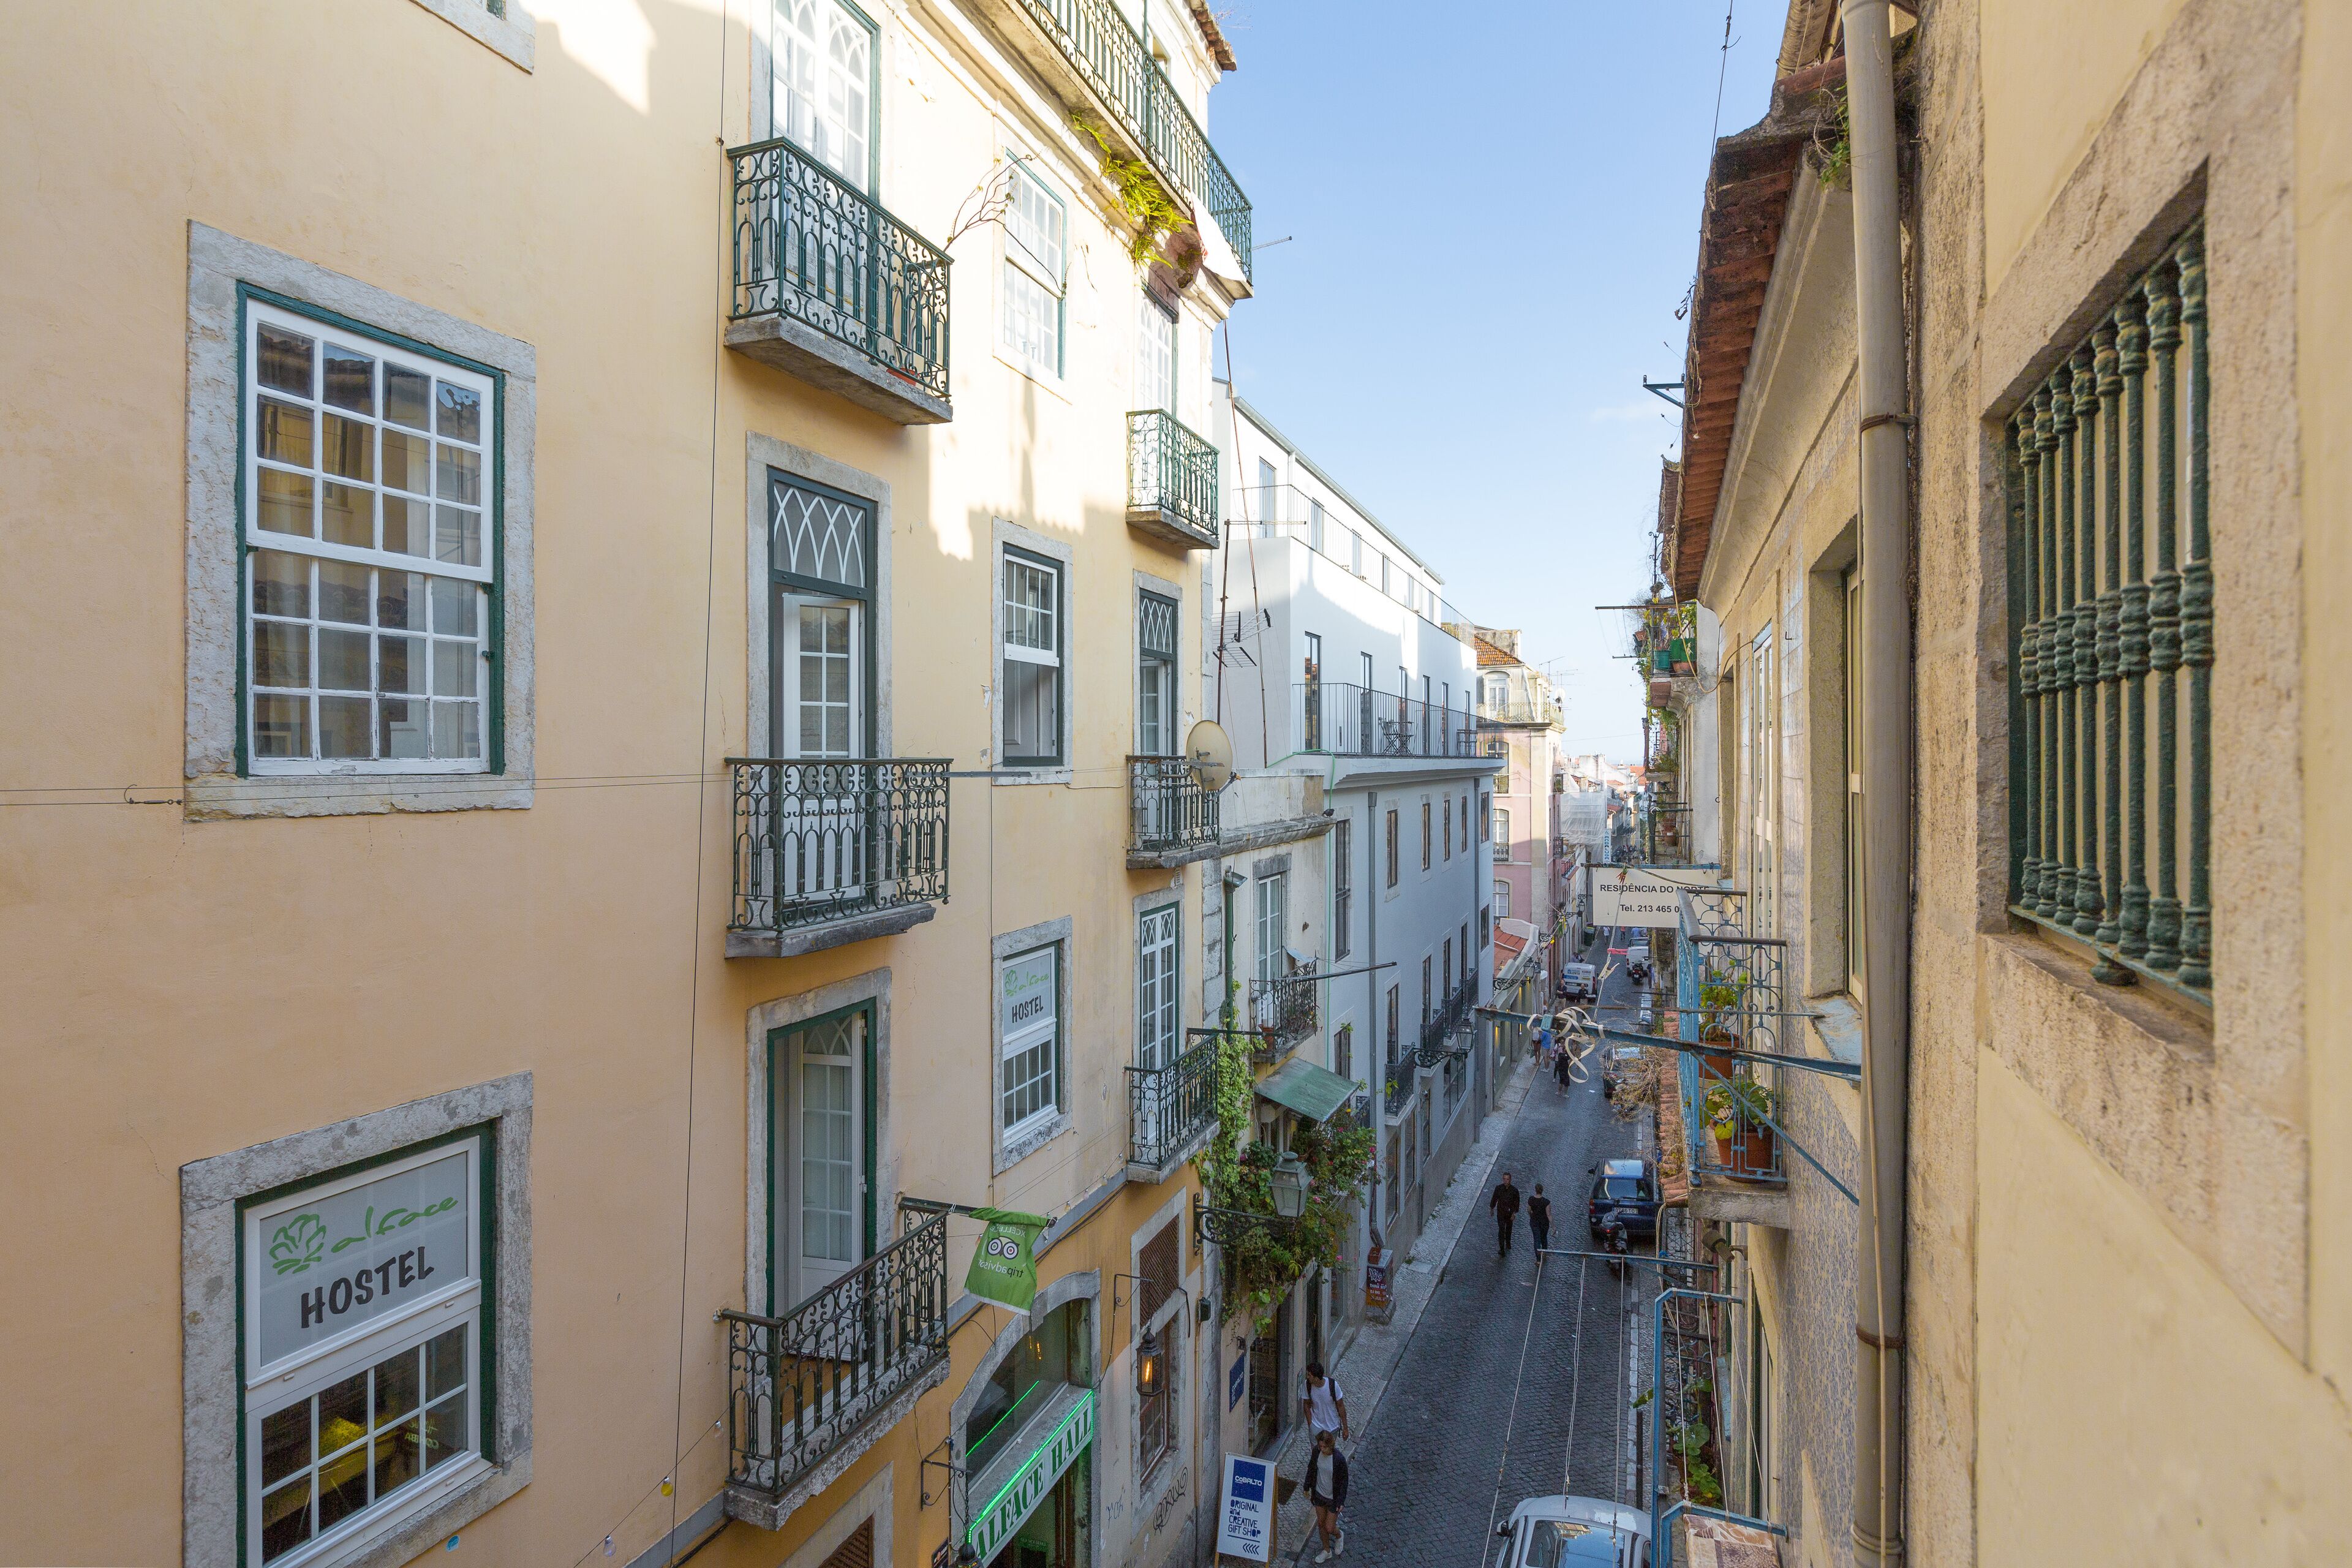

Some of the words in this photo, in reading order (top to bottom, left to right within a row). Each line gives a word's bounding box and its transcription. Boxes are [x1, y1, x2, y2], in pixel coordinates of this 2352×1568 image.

[1600, 883, 1657, 893] RESIDÊNCIA
[1620, 904, 1635, 913] Tel.
[1012, 995, 1044, 1023] HOSTEL
[301, 1246, 435, 1329] HOSTEL
[976, 1461, 1044, 1559] ALFACE
[1051, 1408, 1091, 1479] HALL
[1229, 1507, 1240, 1516] and
[1230, 1499, 1259, 1513] ORIGINAL
[1229, 1515, 1257, 1529] CREATIVE
[1228, 1524, 1242, 1534] GIFT
[1243, 1526, 1261, 1538] SHOP
